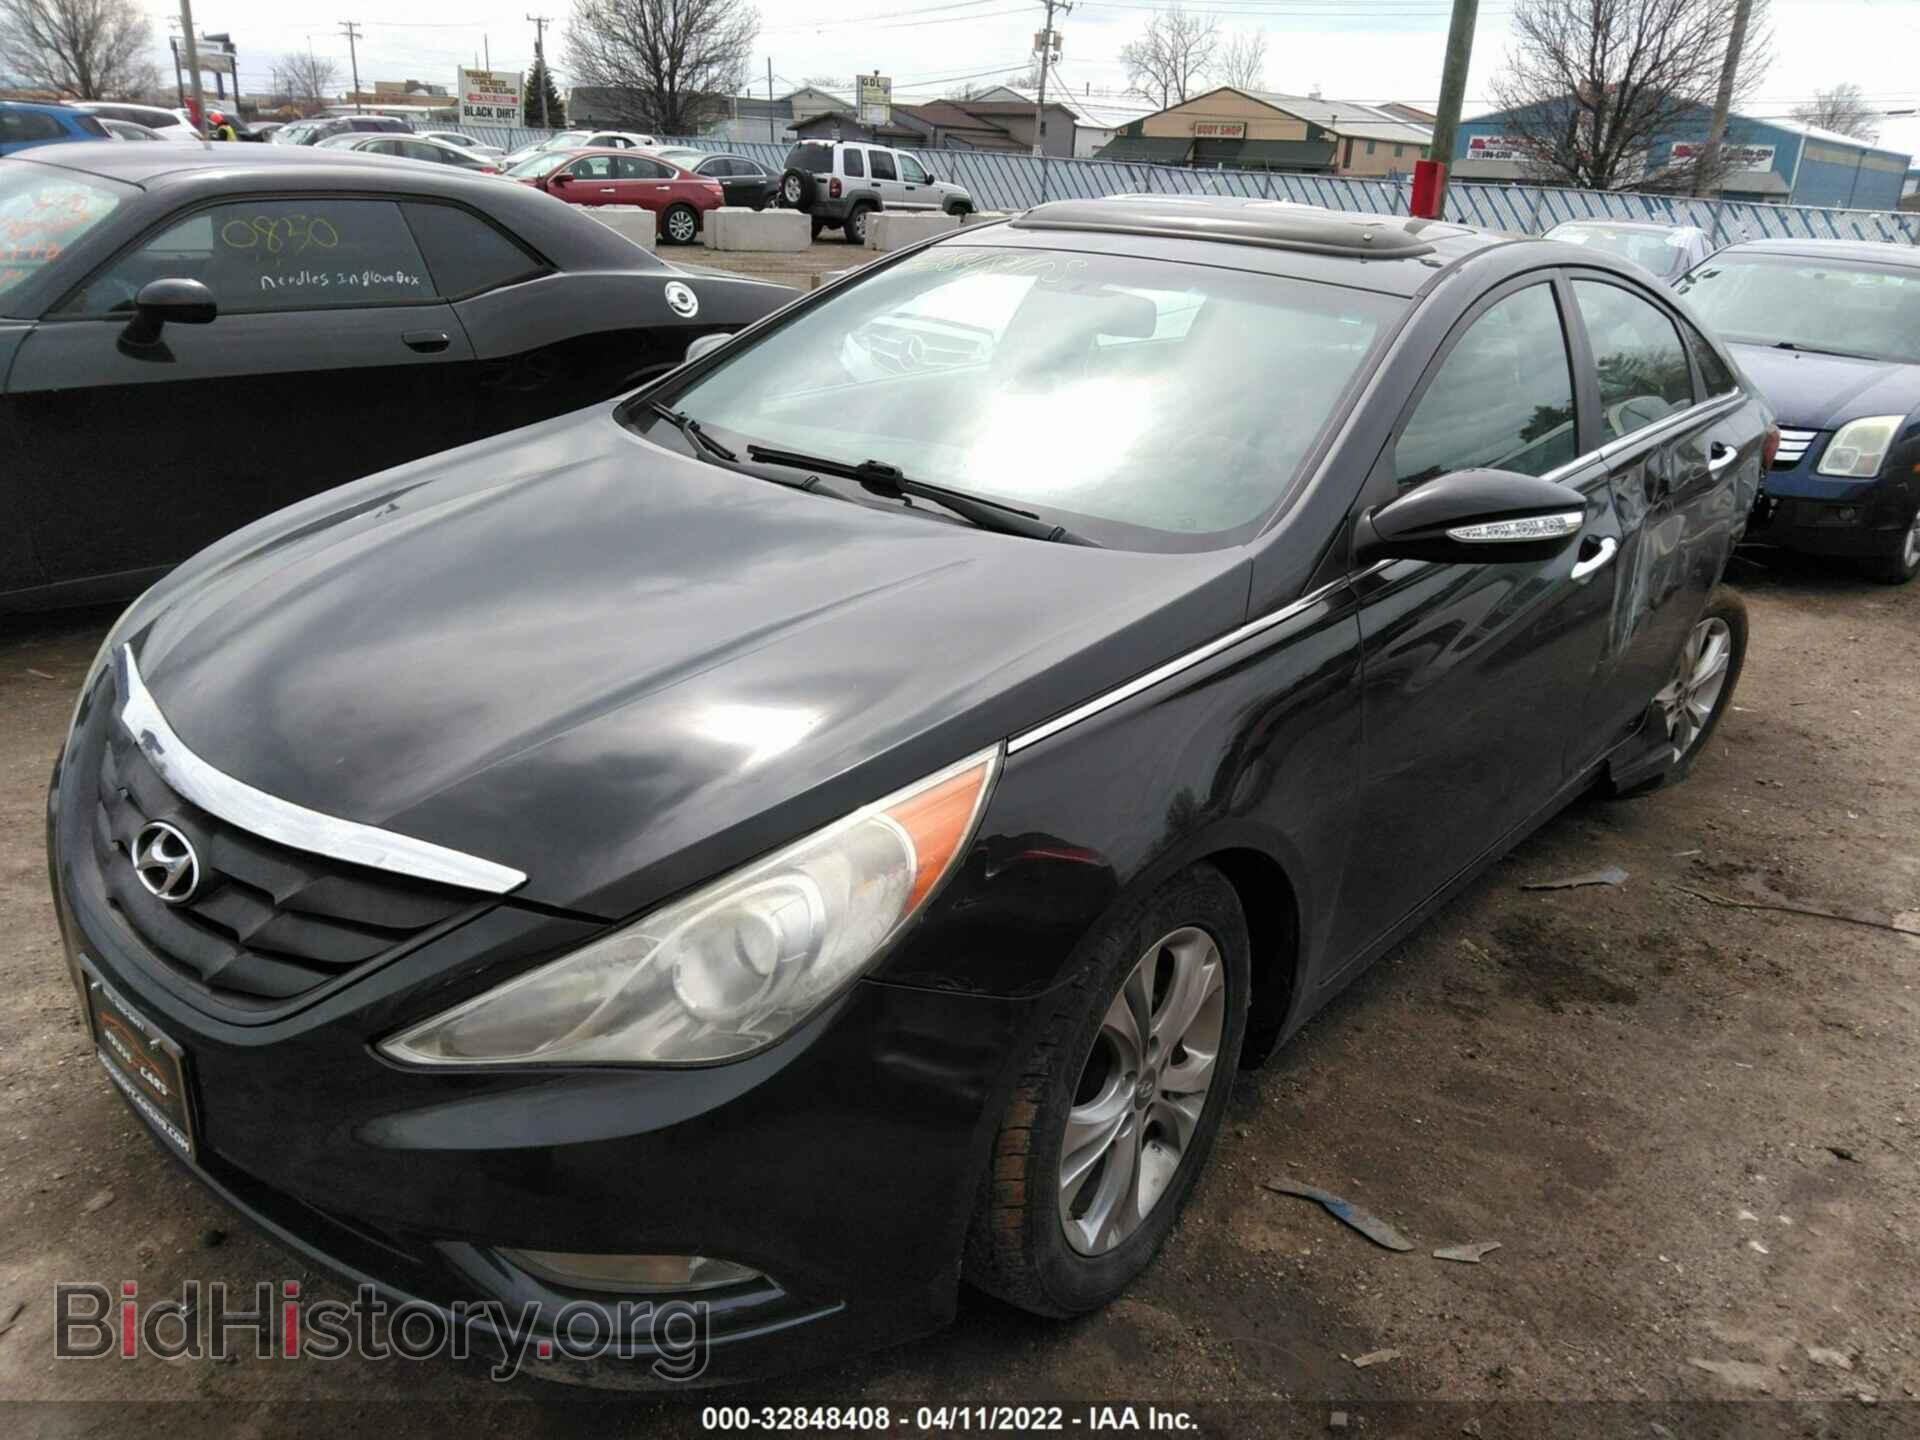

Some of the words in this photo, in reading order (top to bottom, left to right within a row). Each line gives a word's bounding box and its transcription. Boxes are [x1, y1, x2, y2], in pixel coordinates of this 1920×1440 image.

[464, 105, 494, 118] BLACK
[496, 107, 516, 120] DIRT
[1197, 125, 1217, 136] BODY
[1220, 125, 1242, 137] SHOP
